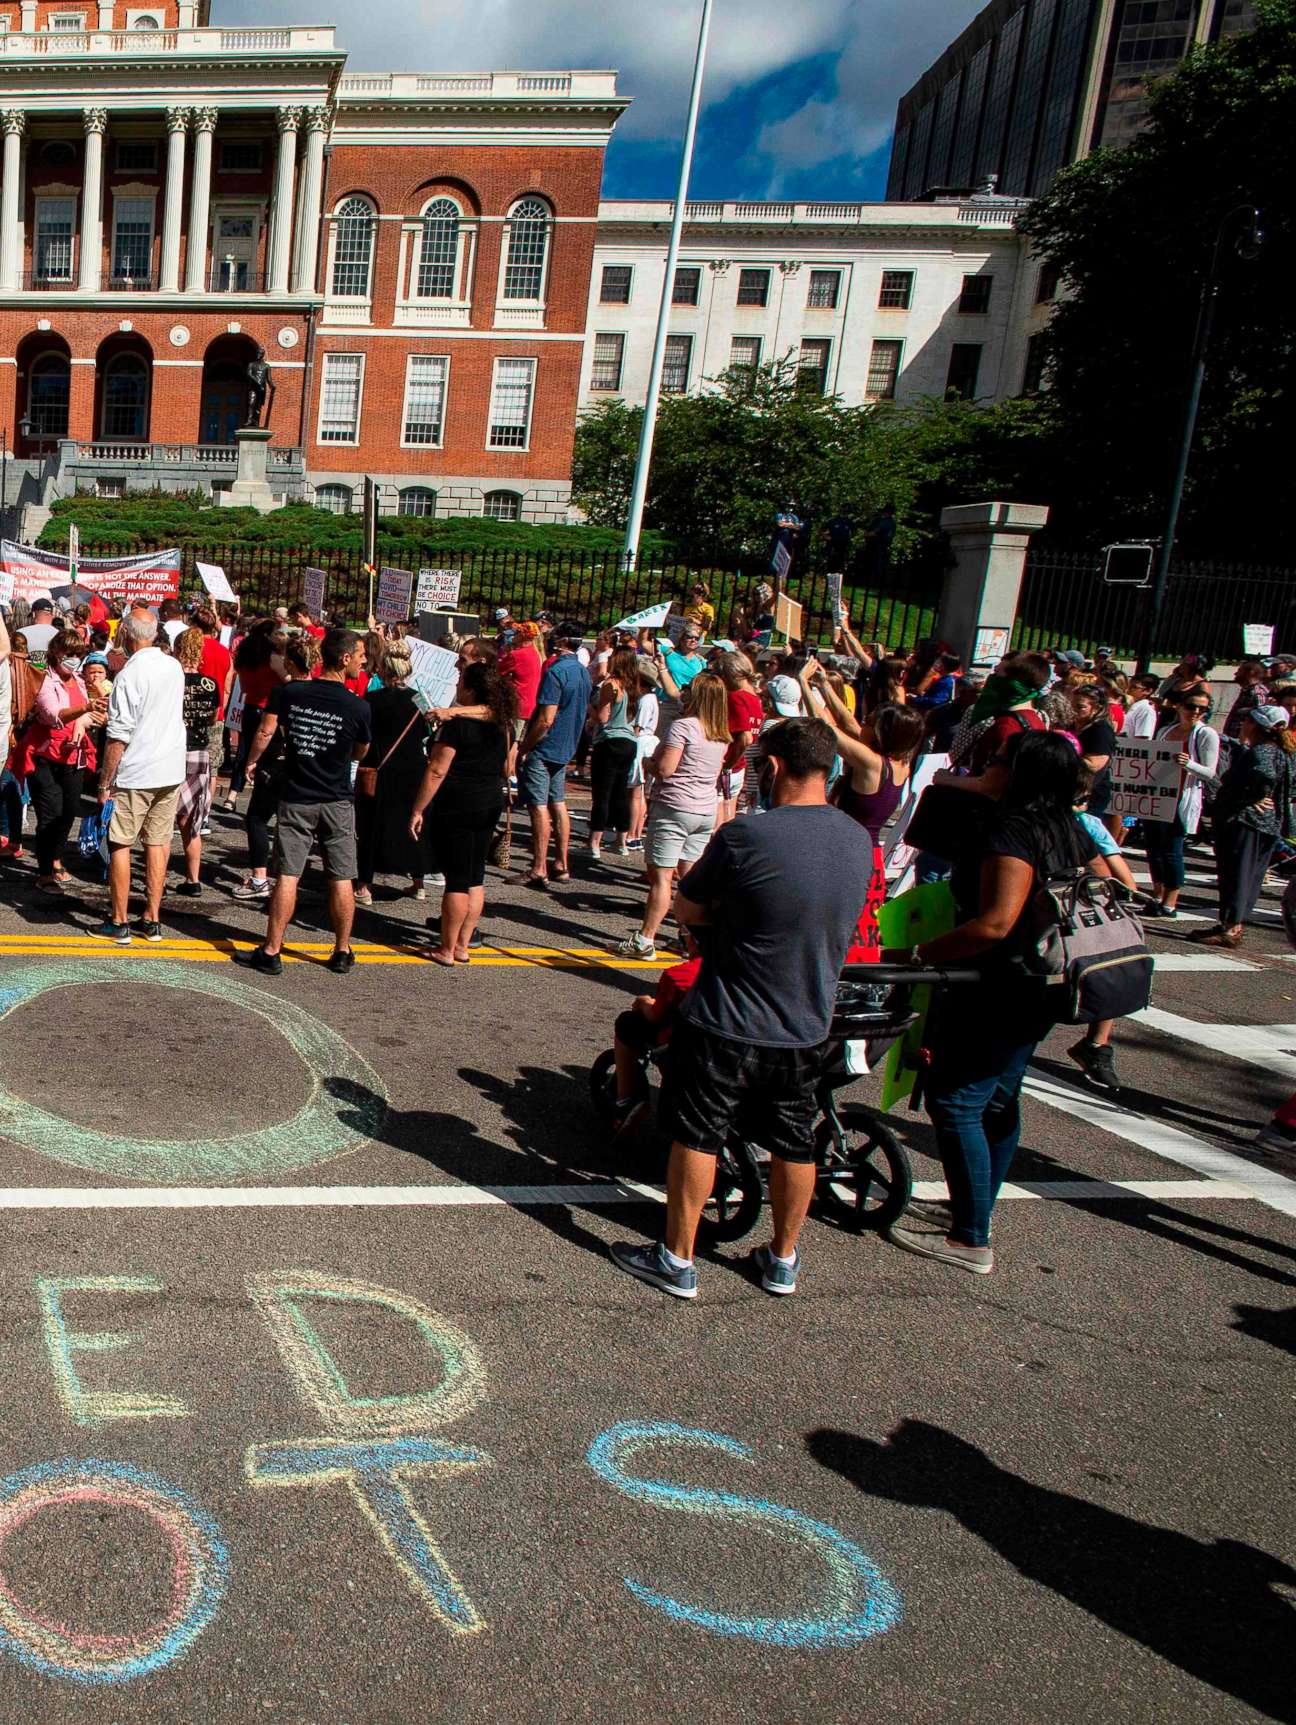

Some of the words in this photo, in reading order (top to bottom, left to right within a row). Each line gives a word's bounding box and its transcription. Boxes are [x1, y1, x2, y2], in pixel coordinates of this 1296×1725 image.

[138, 572, 171, 581] ANSWER.
[435, 576, 455, 585] RISK
[127, 582, 144, 590] THAT
[145, 582, 177, 592] OPTION.
[427, 591, 456, 600] CHOICE
[416, 601, 426, 609] NO
[1157, 751, 1171, 760] IS
[1109, 757, 1156, 781] ISK
[1124, 783, 1157, 796] MUST
[1160, 787, 1179, 798] BE
[1110, 793, 1161, 817] OICE
